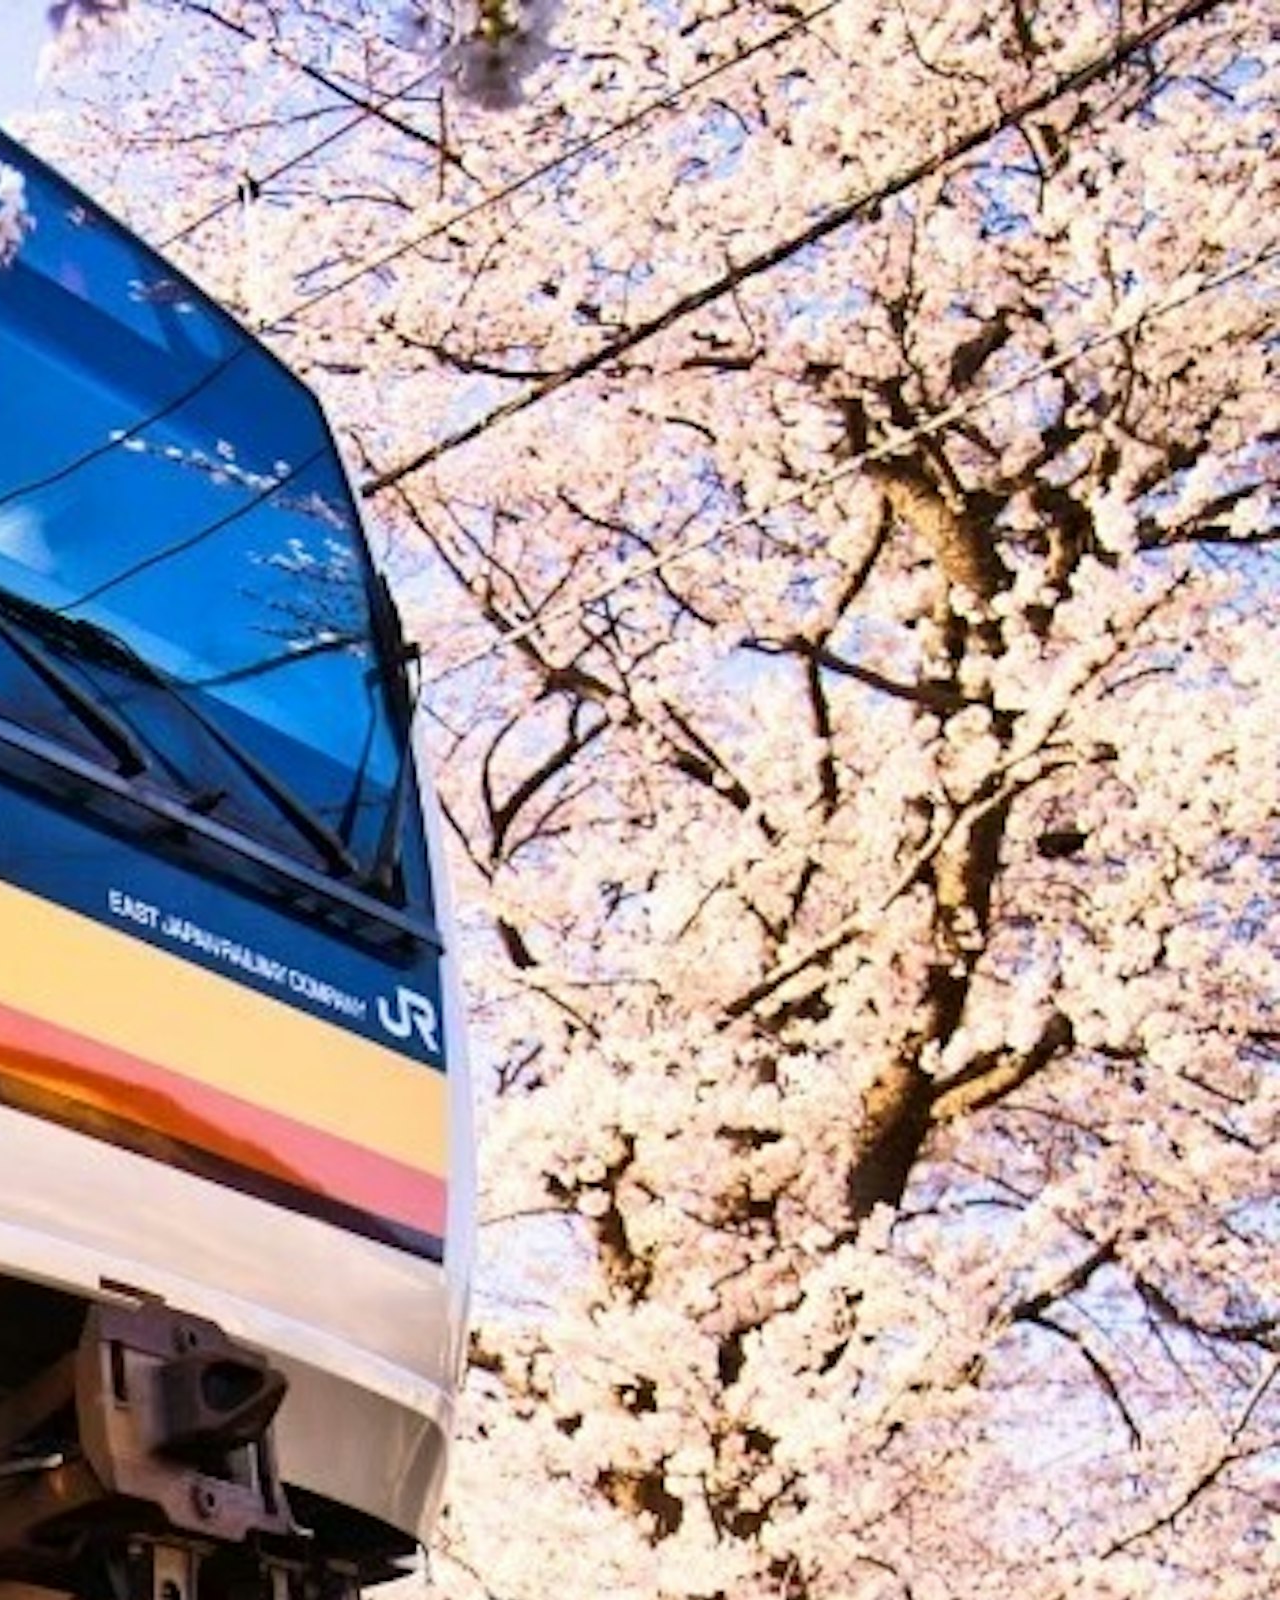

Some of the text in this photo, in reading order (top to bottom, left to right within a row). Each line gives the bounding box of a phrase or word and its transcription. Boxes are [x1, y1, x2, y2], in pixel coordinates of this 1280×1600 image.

[107, 888, 161, 928] EAST
[161, 914, 221, 959] JAPAN
[288, 969, 368, 1020] COMPANY
[378, 985, 441, 1054] JR
